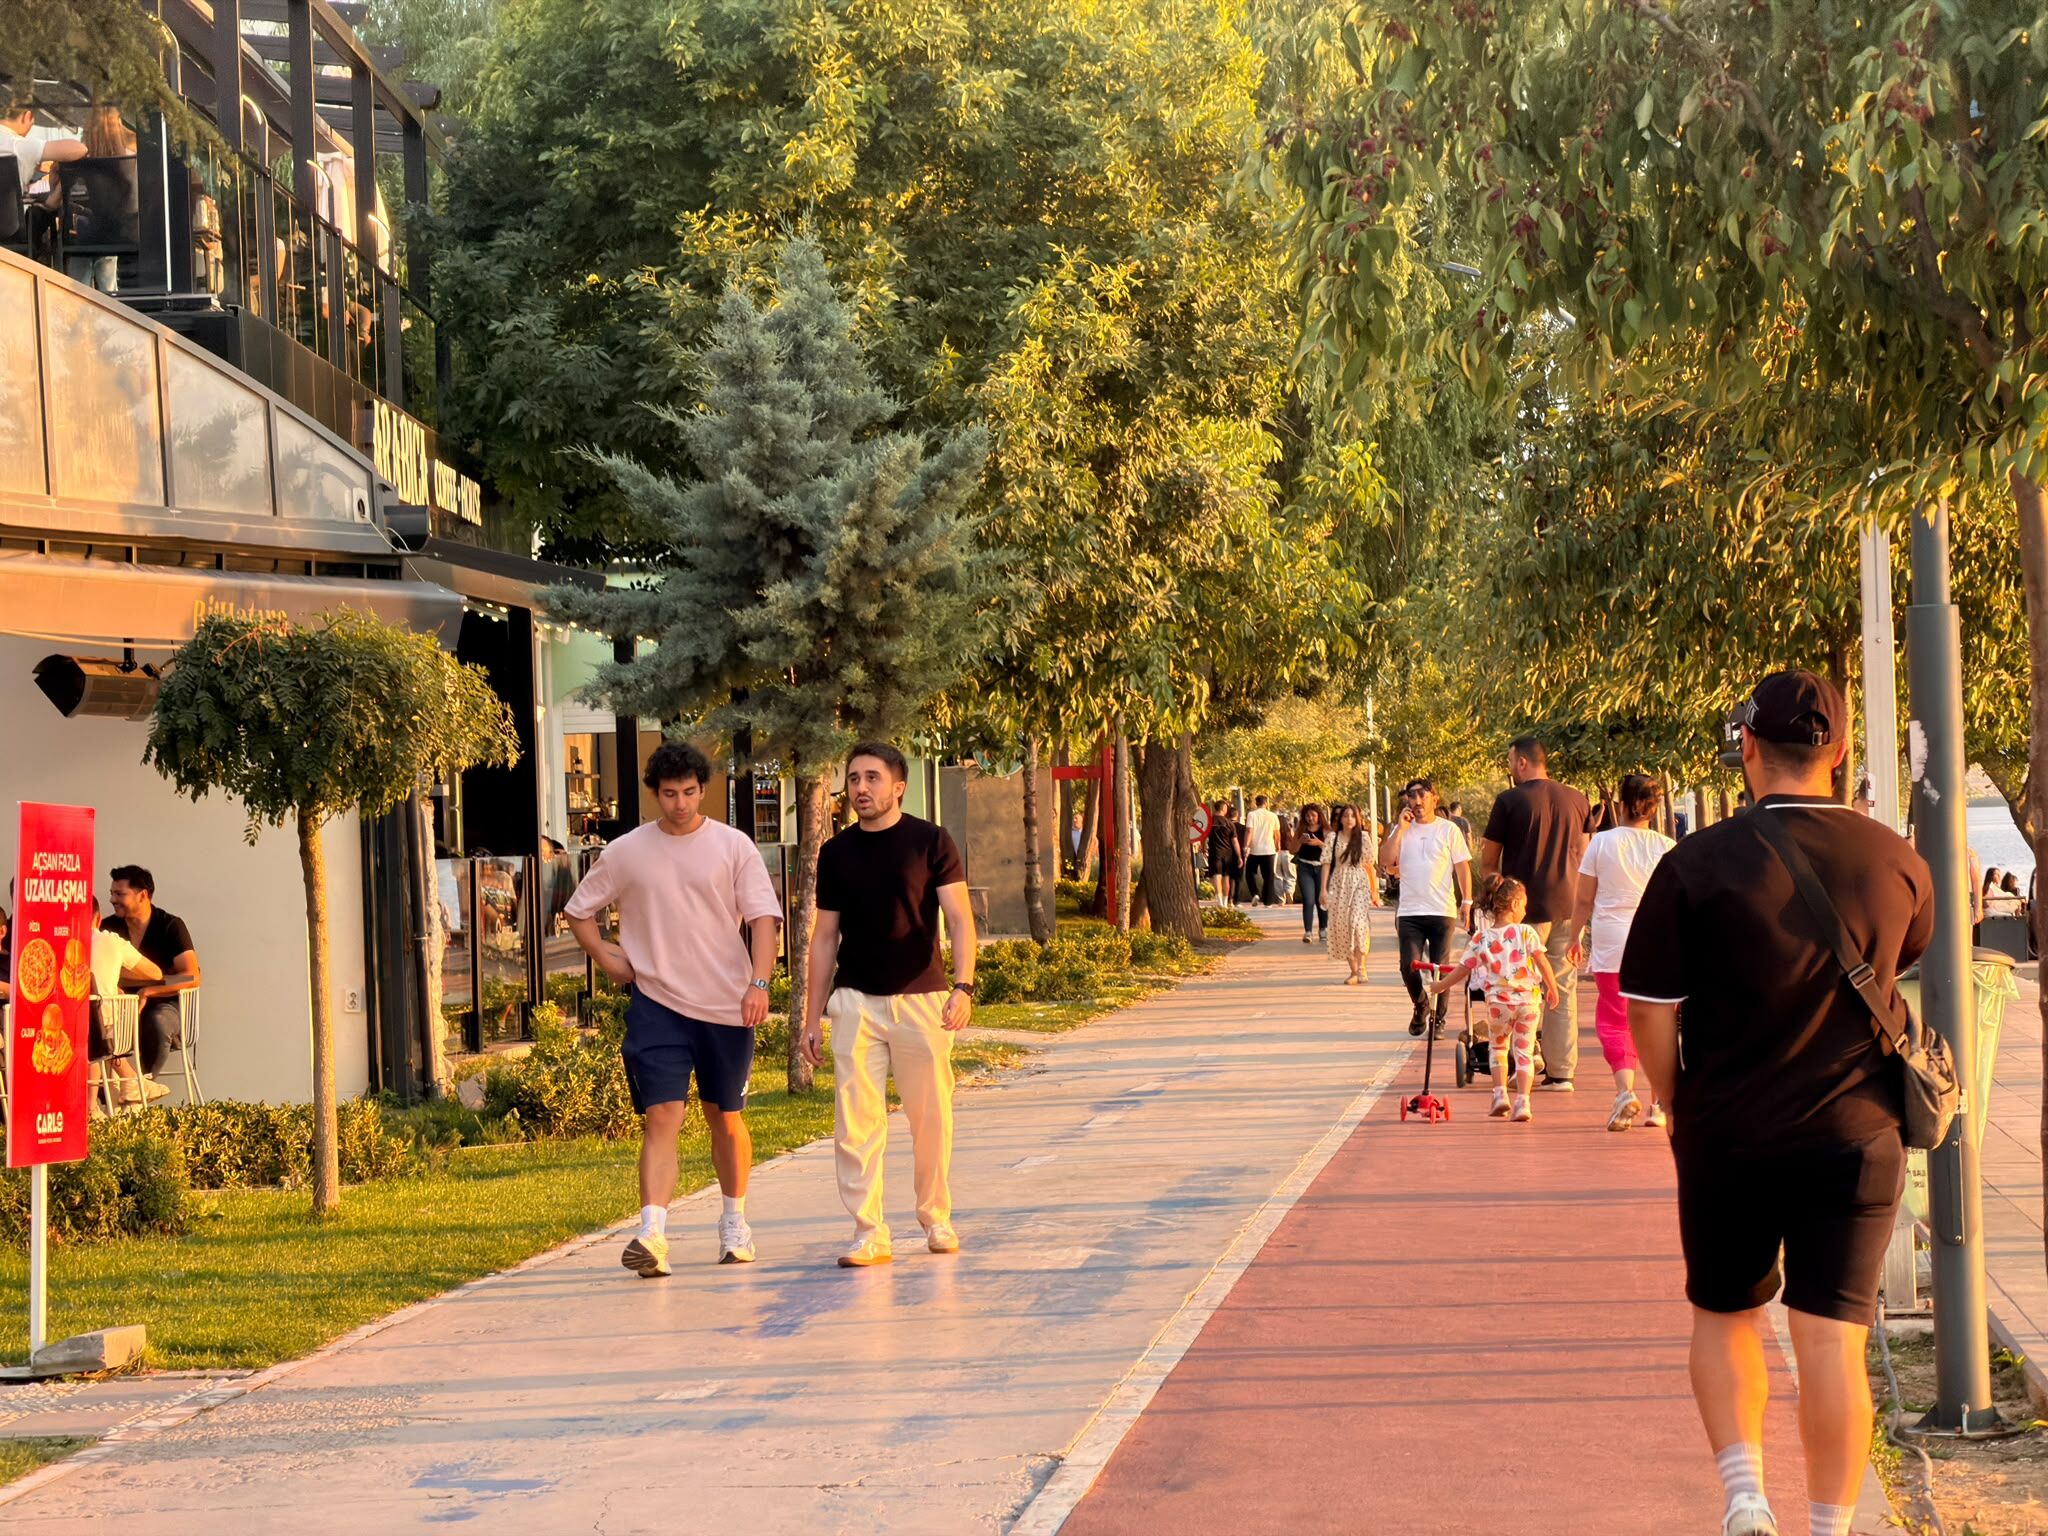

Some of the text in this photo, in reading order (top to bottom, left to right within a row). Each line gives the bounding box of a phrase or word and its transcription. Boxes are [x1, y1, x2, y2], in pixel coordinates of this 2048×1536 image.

[373, 398, 429, 505] ARABICA
[32, 852, 80, 876] AÇSAN FAZLA
[25, 878, 86, 911] UZAKLAŞMA!
[36, 1111, 64, 1134] CARLO
